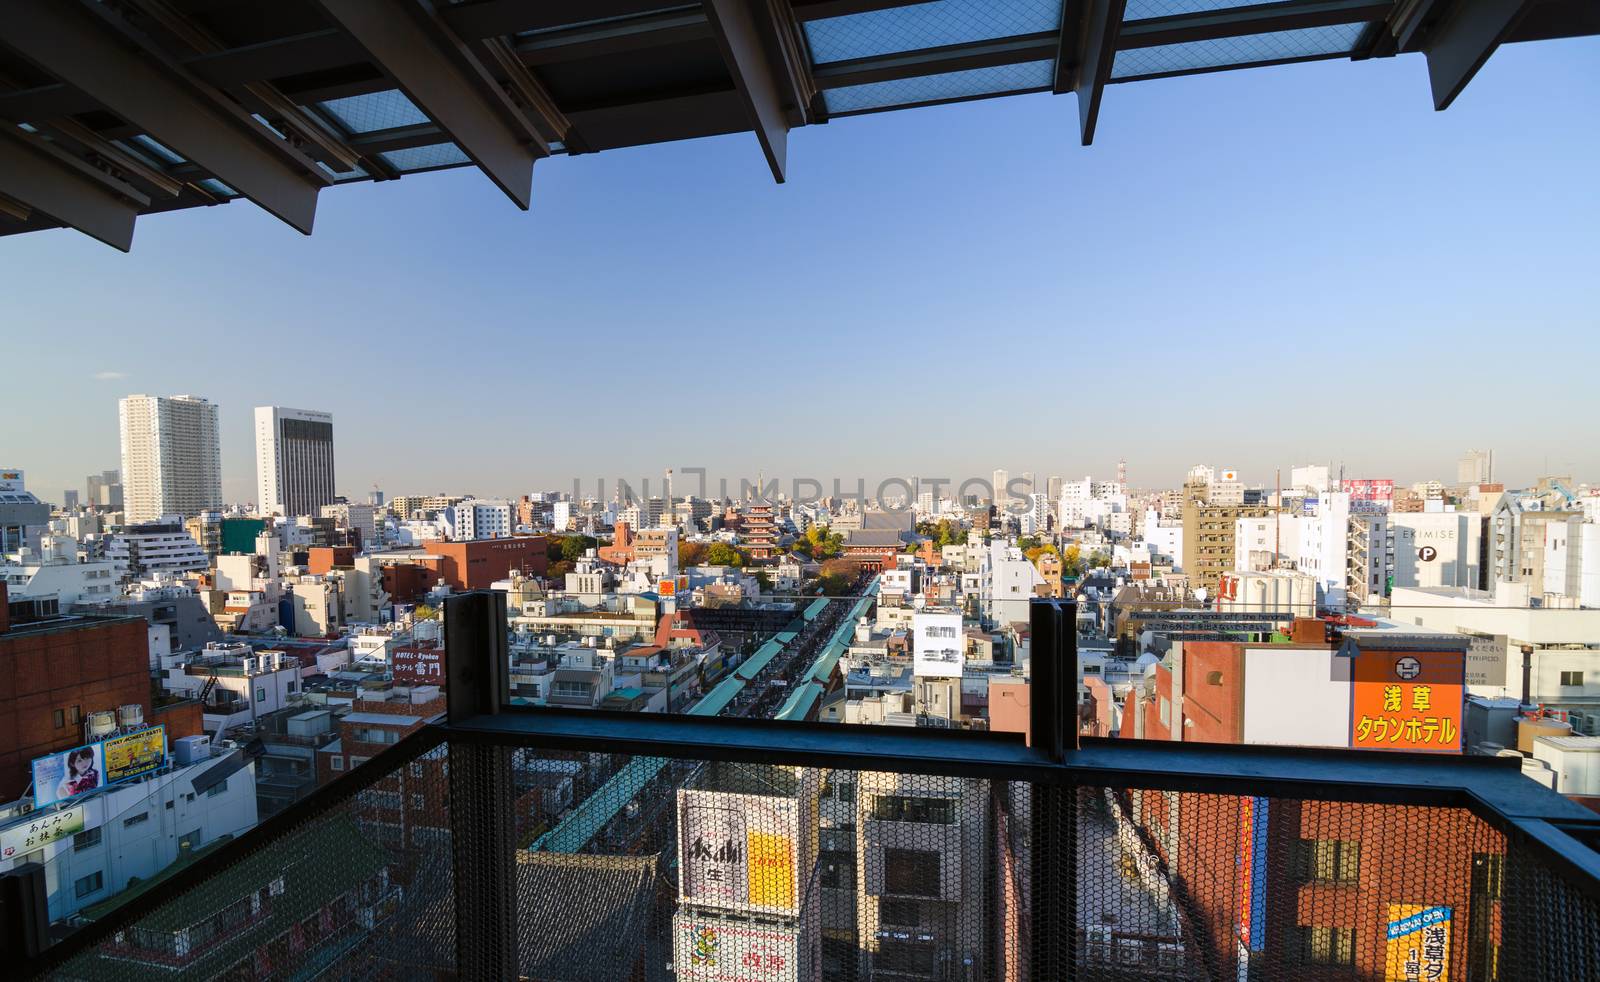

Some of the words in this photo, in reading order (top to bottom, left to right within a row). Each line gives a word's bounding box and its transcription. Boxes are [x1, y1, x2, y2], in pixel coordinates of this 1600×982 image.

[1403, 530, 1455, 539] EKIMISE
[1423, 548, 1434, 560] P
[1130, 612, 1155, 620] Please
[1159, 612, 1176, 621] keep
[1179, 614, 1195, 622] your
[417, 653, 439, 661] Ryokan
[395, 663, 414, 672] ホテル
[415, 661, 441, 677] 雷門
[1383, 685, 1432, 713] 浅草
[1356, 715, 1457, 744] タウンホテル
[29, 812, 73, 833] あんみつ
[25, 826, 63, 846] お抹茶
[688, 837, 742, 864] Asahi
[707, 868, 724, 882] 生
